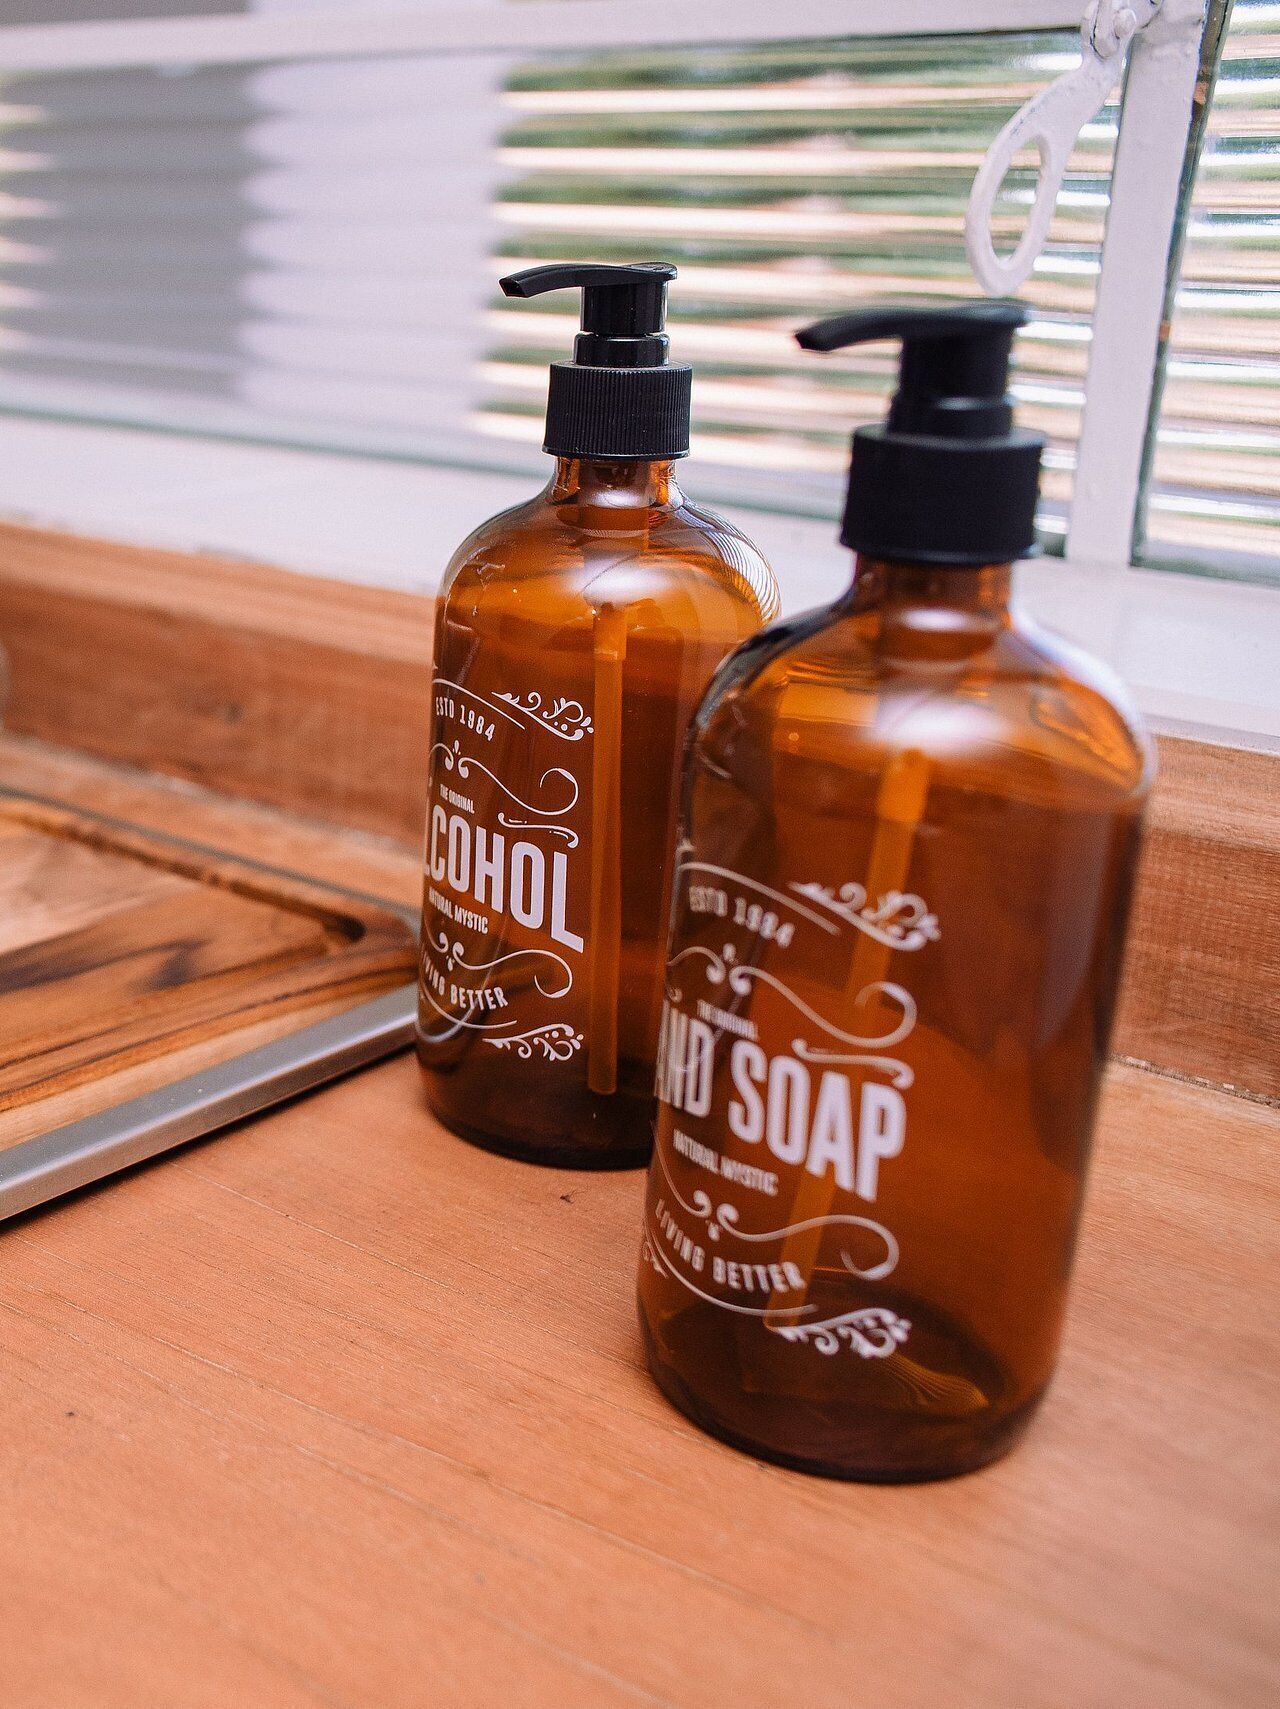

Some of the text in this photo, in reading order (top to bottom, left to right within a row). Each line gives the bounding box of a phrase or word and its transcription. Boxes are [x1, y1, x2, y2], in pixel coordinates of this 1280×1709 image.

[435, 696, 496, 742] ESTD 1984
[455, 904, 489, 935] MYSTIC
[733, 897, 796, 949] 1984
[450, 984, 509, 1011] BETTER
[727, 1039, 907, 1203] SOAP
[712, 1255, 808, 1294] BETTER
